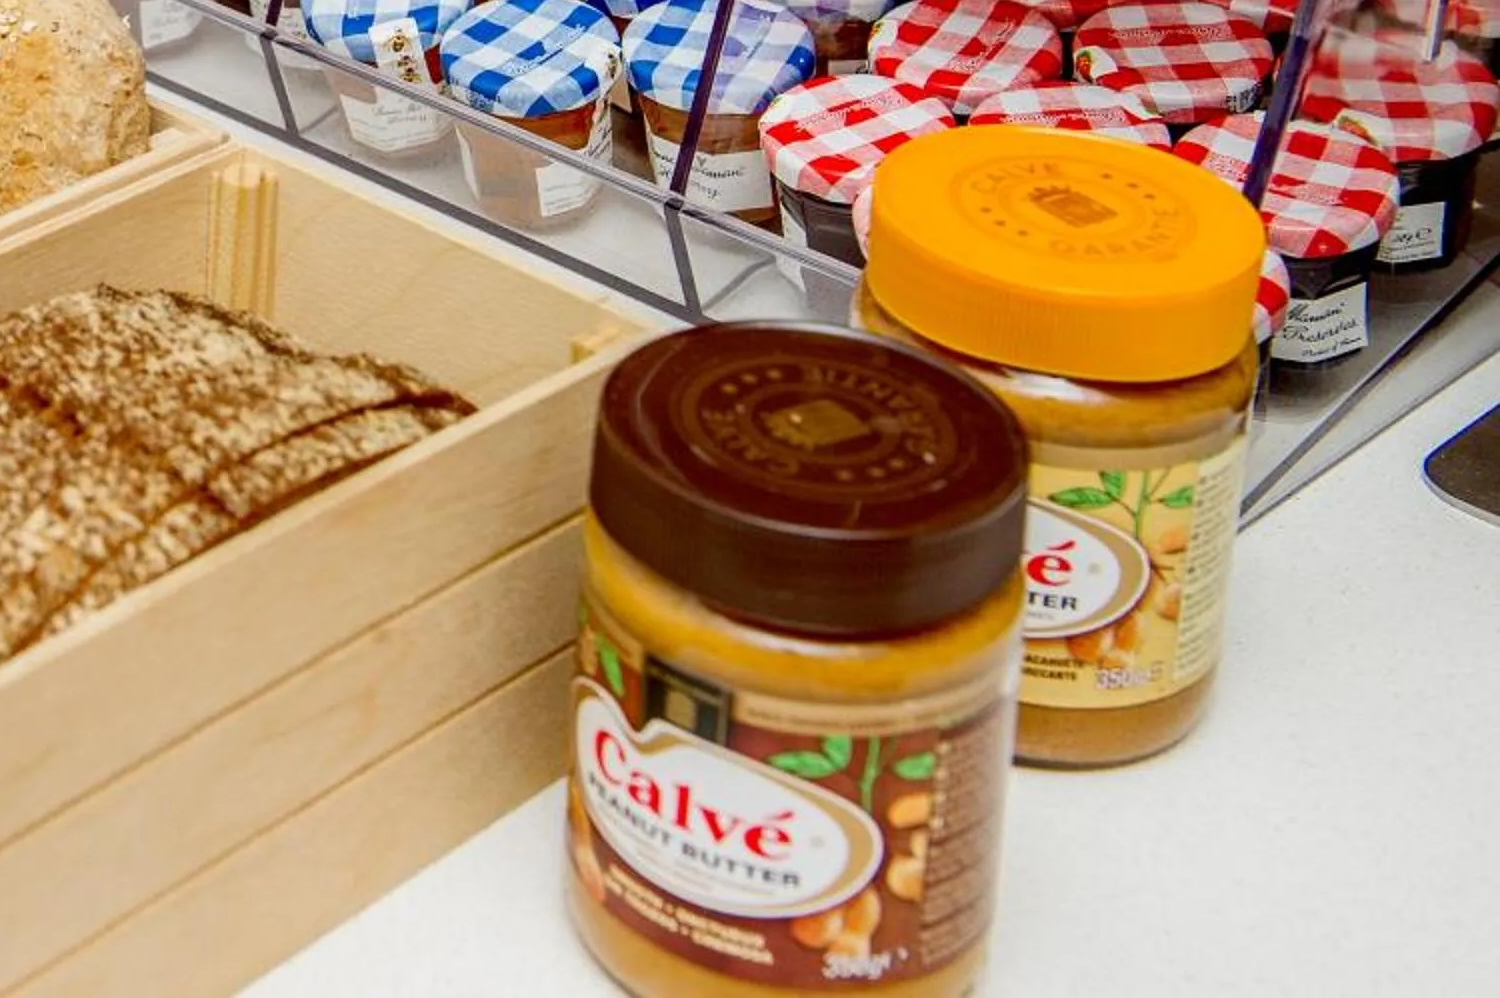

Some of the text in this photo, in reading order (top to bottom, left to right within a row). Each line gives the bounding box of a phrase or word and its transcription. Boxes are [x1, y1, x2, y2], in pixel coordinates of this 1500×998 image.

[1027, 590, 1078, 611] TER
[588, 772, 800, 886] PEANUT BUTTER
[595, 729, 795, 859] Calvé
